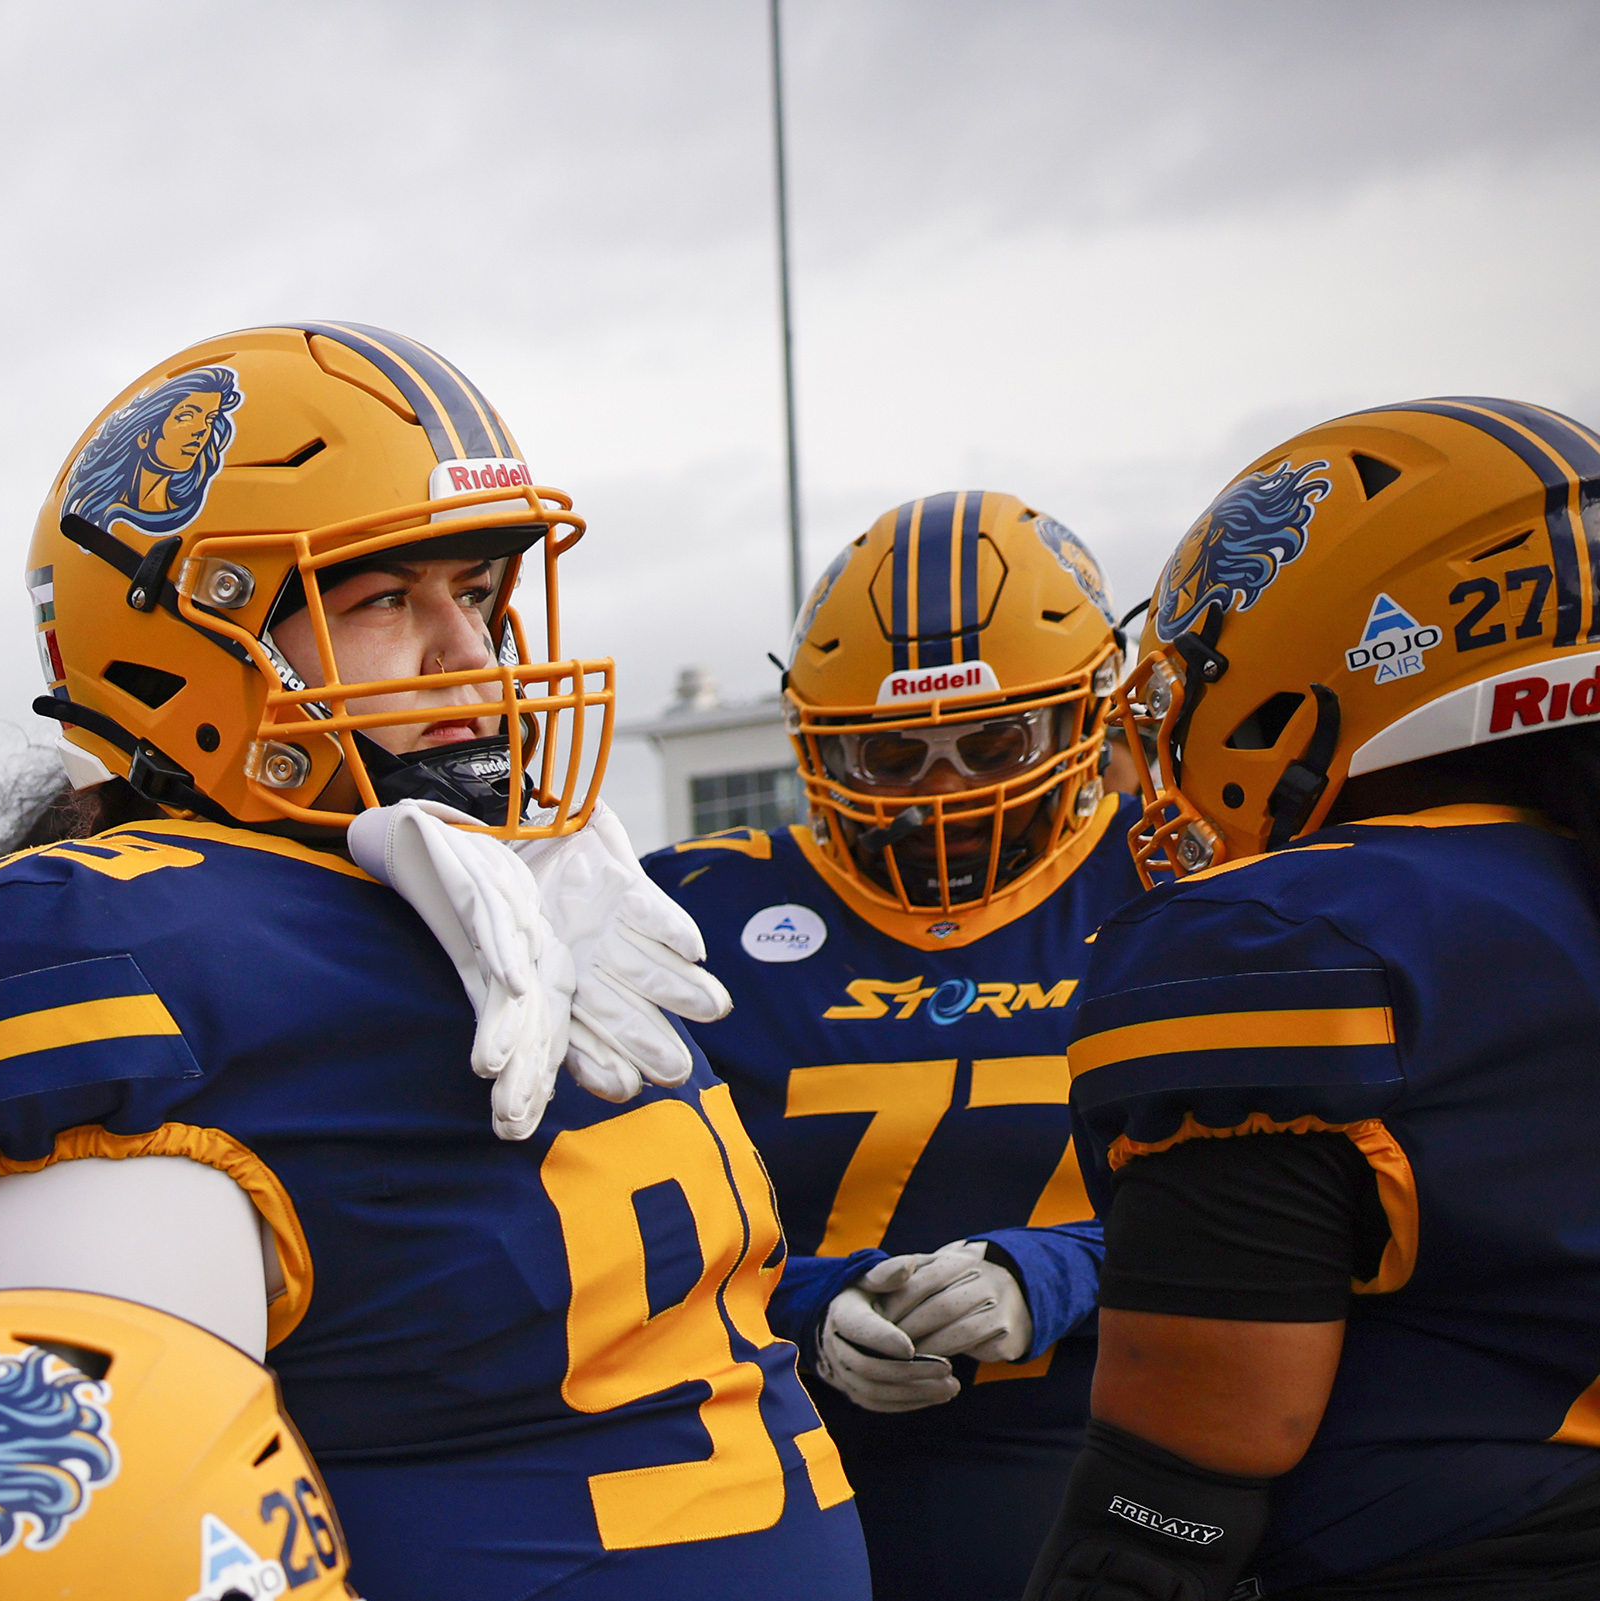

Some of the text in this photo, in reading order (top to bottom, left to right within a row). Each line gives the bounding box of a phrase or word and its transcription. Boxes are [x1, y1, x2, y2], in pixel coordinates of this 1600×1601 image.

[448, 463, 533, 491] Riddell
[1448, 564, 1554, 652] 27
[1348, 628, 1439, 669] DOJO
[1377, 654, 1422, 682] AIR
[892, 667, 982, 697] Riddell
[756, 932, 811, 944] DOJO
[822, 975, 1080, 1026] STORM
[784, 1056, 1097, 1385] 77
[259, 1476, 337, 1590] 26
[1109, 1499, 1217, 1542] FRELAXY
